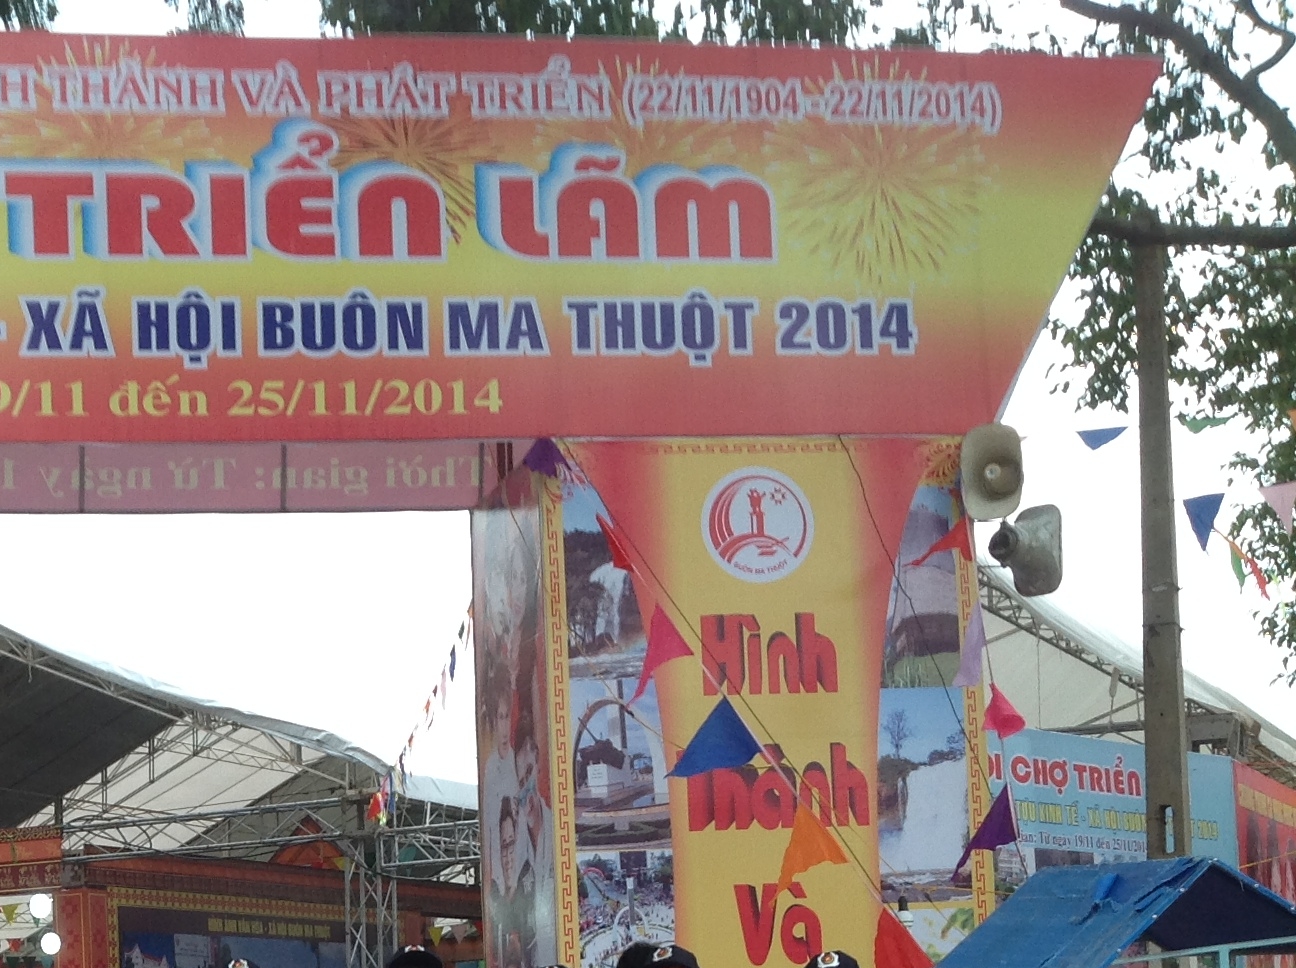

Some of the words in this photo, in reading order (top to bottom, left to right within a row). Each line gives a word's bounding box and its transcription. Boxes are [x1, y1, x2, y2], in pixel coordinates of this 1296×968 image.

[49, 56, 226, 115] THÀNH
[232, 60, 310, 118] VÀ
[461, 54, 612, 120] TRIỂN
[474, 142, 777, 263] LÃM
[21, 288, 113, 358] XÃ
[133, 288, 243, 369] HỘI
[260, 289, 429, 357] BUÔN
[443, 299, 547, 356] MA
[565, 290, 757, 367] THUỘT
[777, 299, 917, 356] 2014
[109, 374, 209, 418] đến
[228, 378, 503, 419] 25/11/2014
[700, 612, 839, 696] Hình
[1011, 755, 1068, 795] CHỢ
[1073, 755, 1142, 796] TRIỂN
[1038, 801, 1063, 825] KINH
[734, 881, 823, 967] Và
